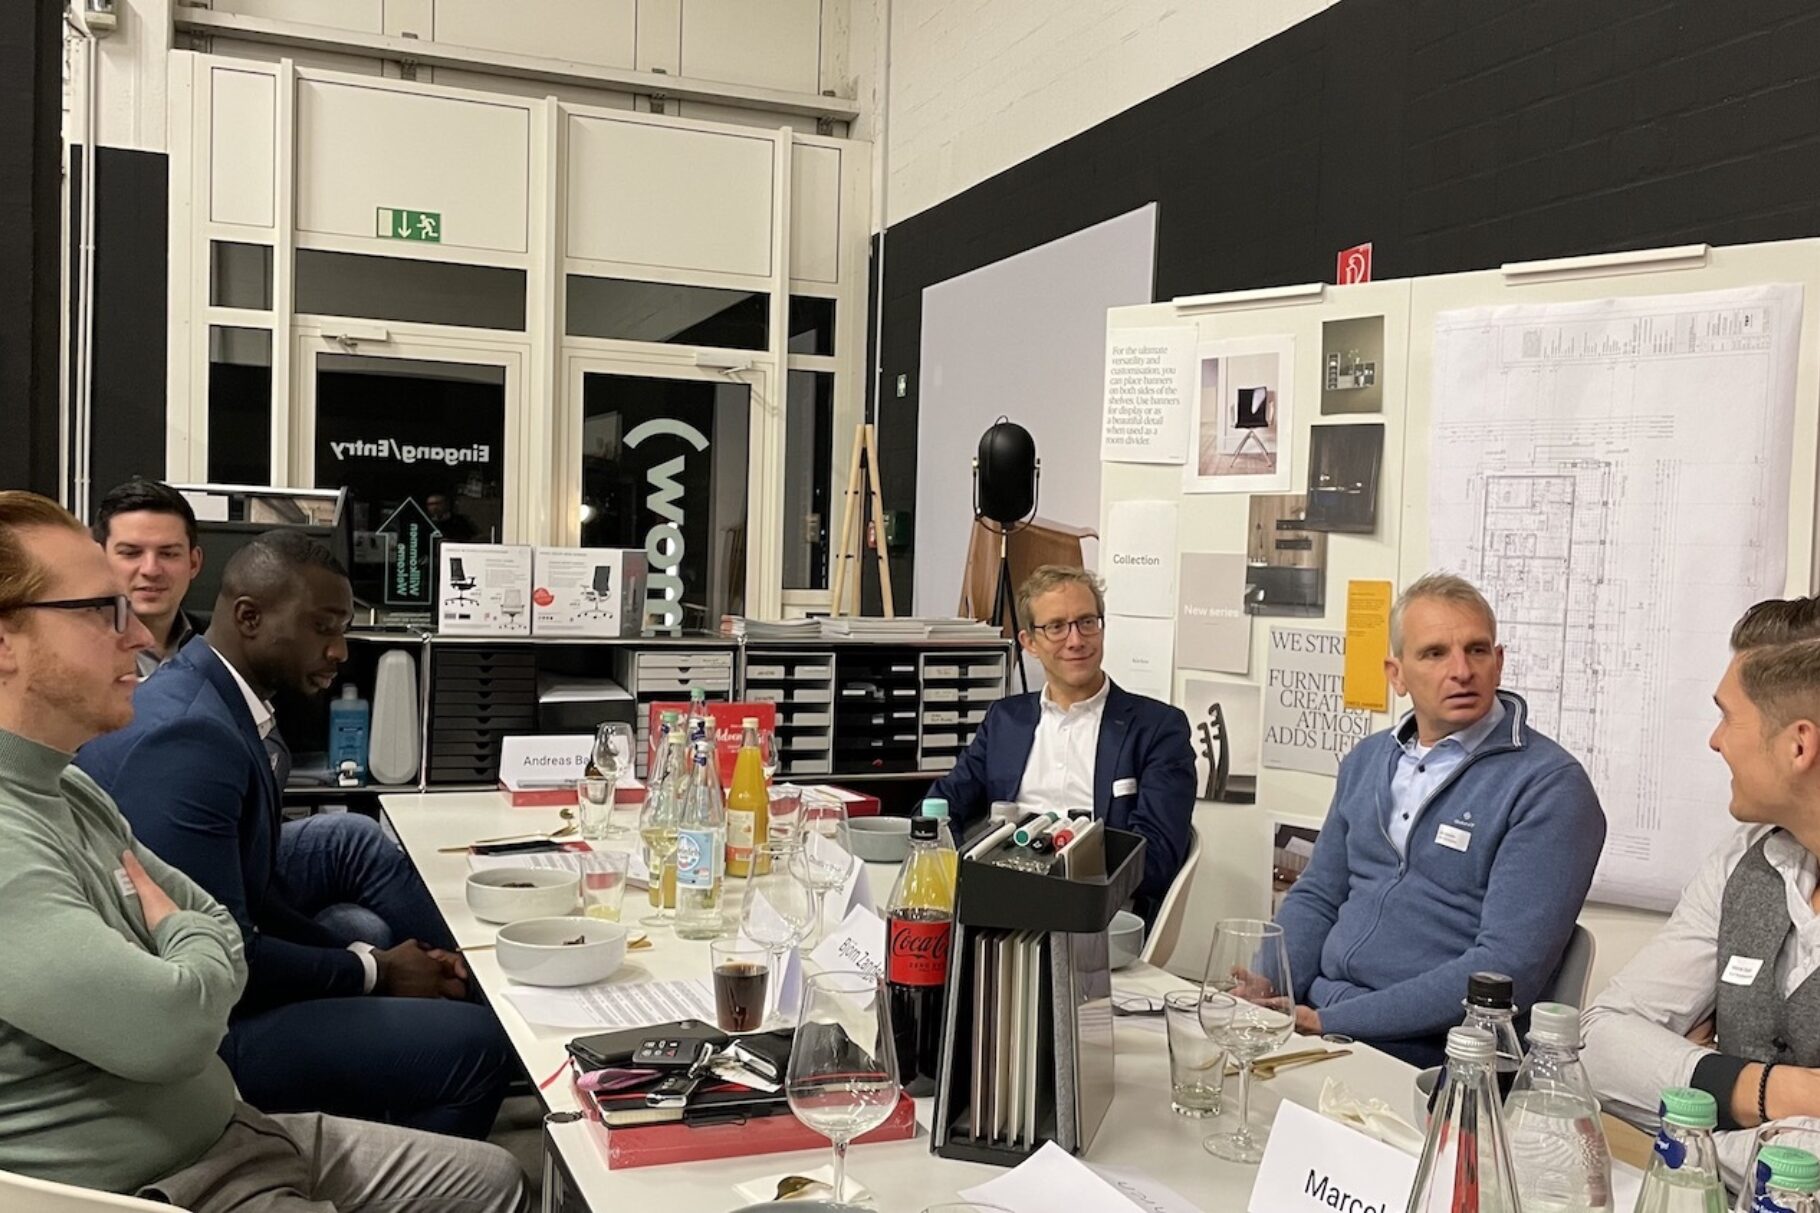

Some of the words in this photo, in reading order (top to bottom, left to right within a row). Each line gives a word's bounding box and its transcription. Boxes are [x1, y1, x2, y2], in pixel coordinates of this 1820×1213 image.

[1112, 346, 1124, 355] For
[1125, 346, 1137, 355] the
[1138, 345, 1168, 355] ultimate
[1112, 355, 1144, 366] versatility
[1145, 355, 1160, 365] and
[1160, 367, 1176, 377] you
[1109, 377, 1122, 386] can
[1123, 376, 1142, 387] place
[1143, 376, 1173, 386] banners
[1108, 387, 1119, 395] on
[1119, 385, 1136, 395] both
[1137, 385, 1155, 395] sides
[1165, 385, 1178, 395] the
[1136, 395, 1149, 405] Use
[1150, 395, 1180, 406] banners
[1107, 405, 1117, 415] for
[1118, 405, 1142, 416] display
[1112, 415, 1143, 425] beautiful
[1144, 415, 1164, 425] detail
[1106, 425, 1126, 435] when
[1126, 425, 1143, 435] used
[1105, 437, 1124, 445] room
[1113, 553, 1160, 566] Collection
[1184, 604, 1208, 616] New
[1209, 605, 1240, 618] series
[1271, 631, 1302, 652] WE
[1305, 633, 1346, 656] STRI
[1280, 689, 1365, 716] CREAT
[1264, 726, 1317, 749] ADDS
[523, 755, 572, 767] Andreas
[575, 754, 591, 766] Ba
[838, 937, 861, 963] Björn
